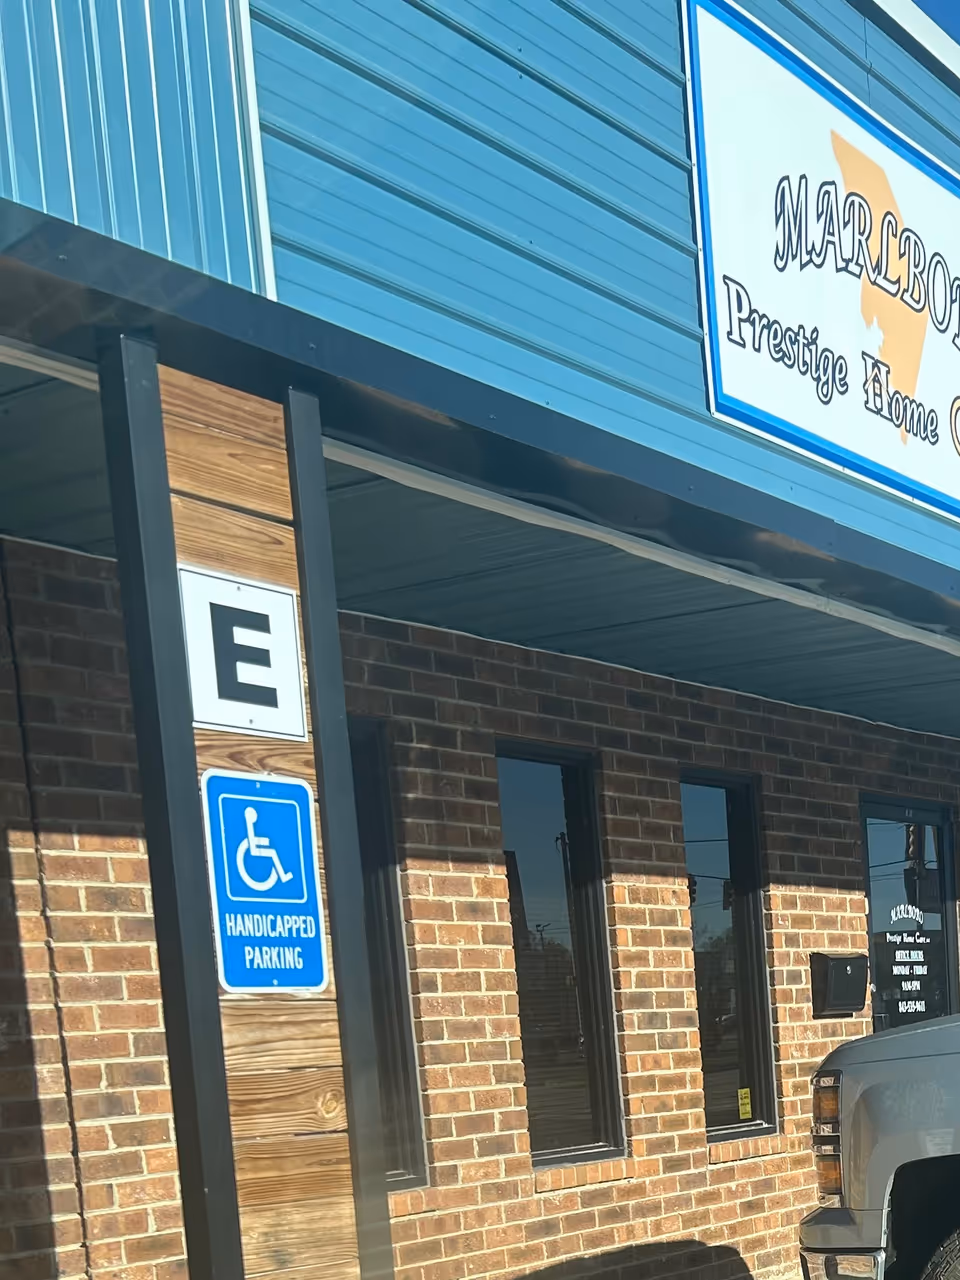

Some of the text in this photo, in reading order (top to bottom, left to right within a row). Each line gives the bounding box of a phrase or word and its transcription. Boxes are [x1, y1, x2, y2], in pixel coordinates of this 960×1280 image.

[722, 274, 849, 405] Prestige
[861, 350, 940, 446] Home
[209, 602, 279, 708] E
[225, 912, 316, 939] HANDICAPPED
[890, 903, 924, 925] MARLBORO
[244, 945, 303, 970] PARKING
